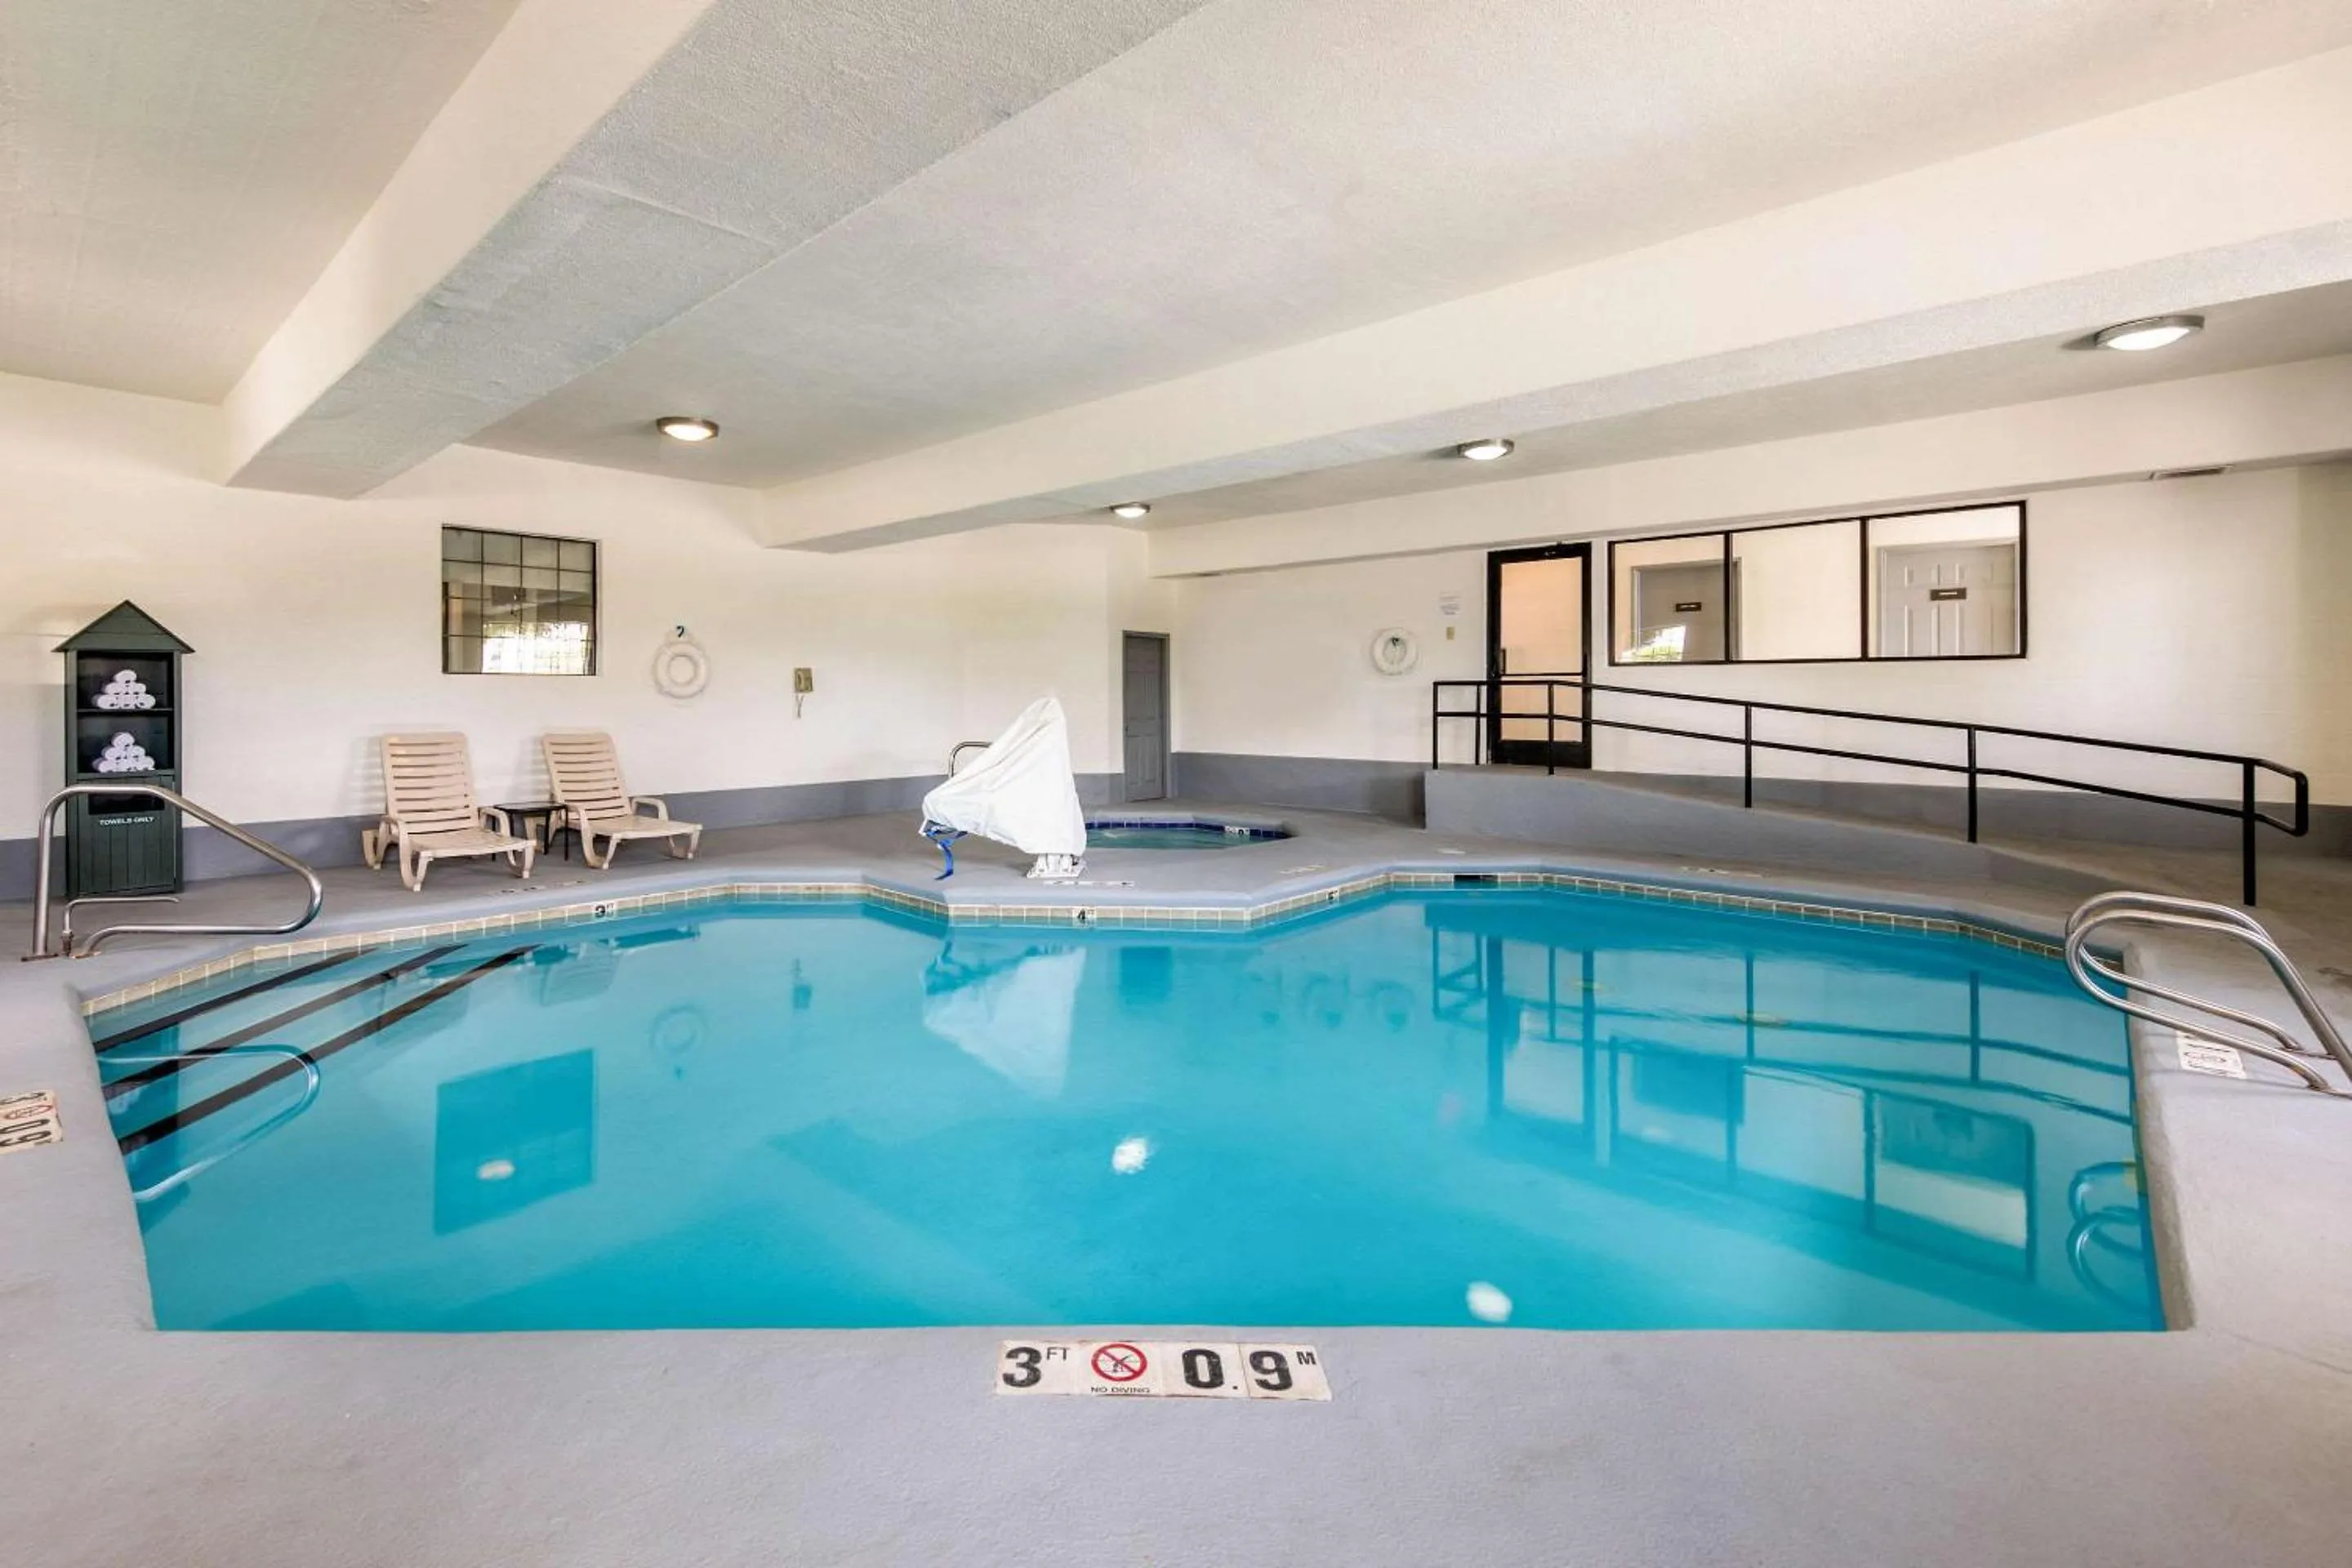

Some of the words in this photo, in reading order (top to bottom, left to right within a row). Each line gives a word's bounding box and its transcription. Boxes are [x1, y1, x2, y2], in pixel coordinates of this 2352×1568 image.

[99, 817, 132, 826] TOWELS
[1296, 1351, 1316, 1365] M
[1002, 1346, 1042, 1388] 3
[1046, 1346, 1070, 1361] FT
